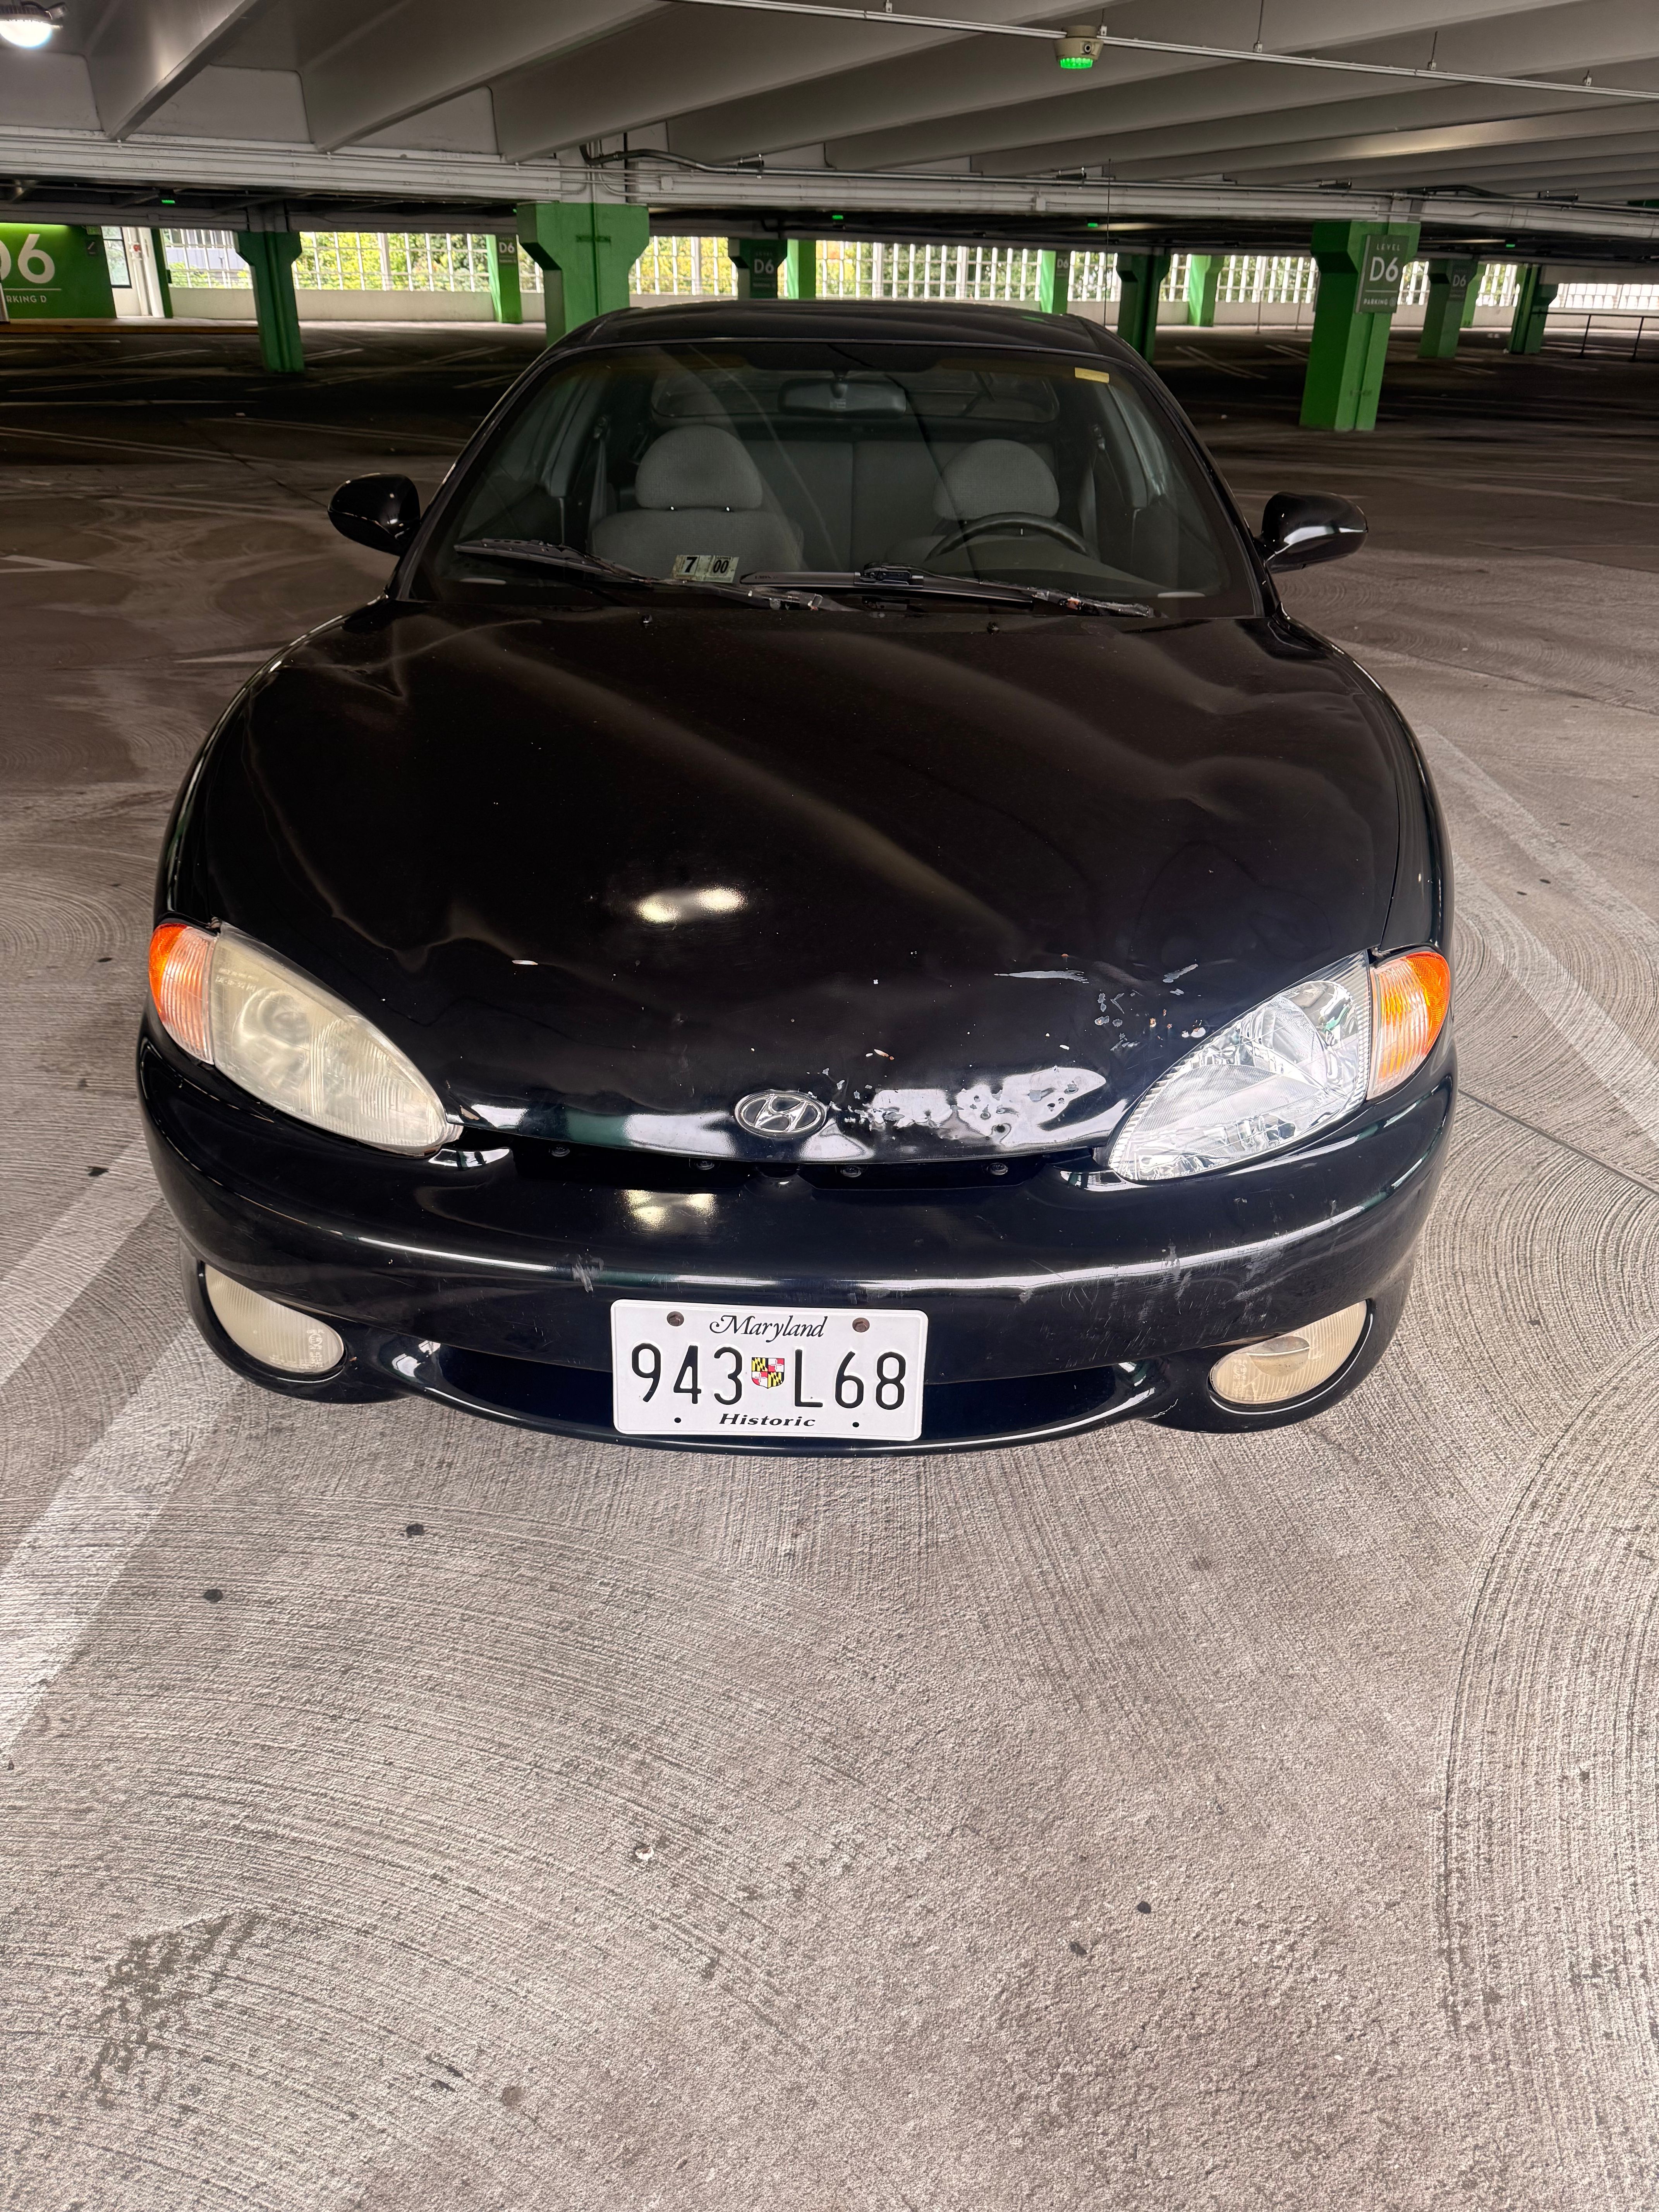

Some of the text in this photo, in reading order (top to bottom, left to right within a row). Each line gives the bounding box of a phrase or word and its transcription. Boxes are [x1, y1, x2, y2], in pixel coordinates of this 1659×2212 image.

[499, 242, 515, 254] D6
[0, 234, 55, 283] 6
[754, 259, 774, 274] D6
[1057, 258, 1069, 268] D6
[1369, 256, 1398, 282] D6
[1453, 275, 1466, 287] D6
[685, 556, 729, 573] 7 00
[709, 1314, 828, 1343] Maryland
[631, 1342, 907, 1410] 943 L68
[718, 1413, 816, 1427] Historic
